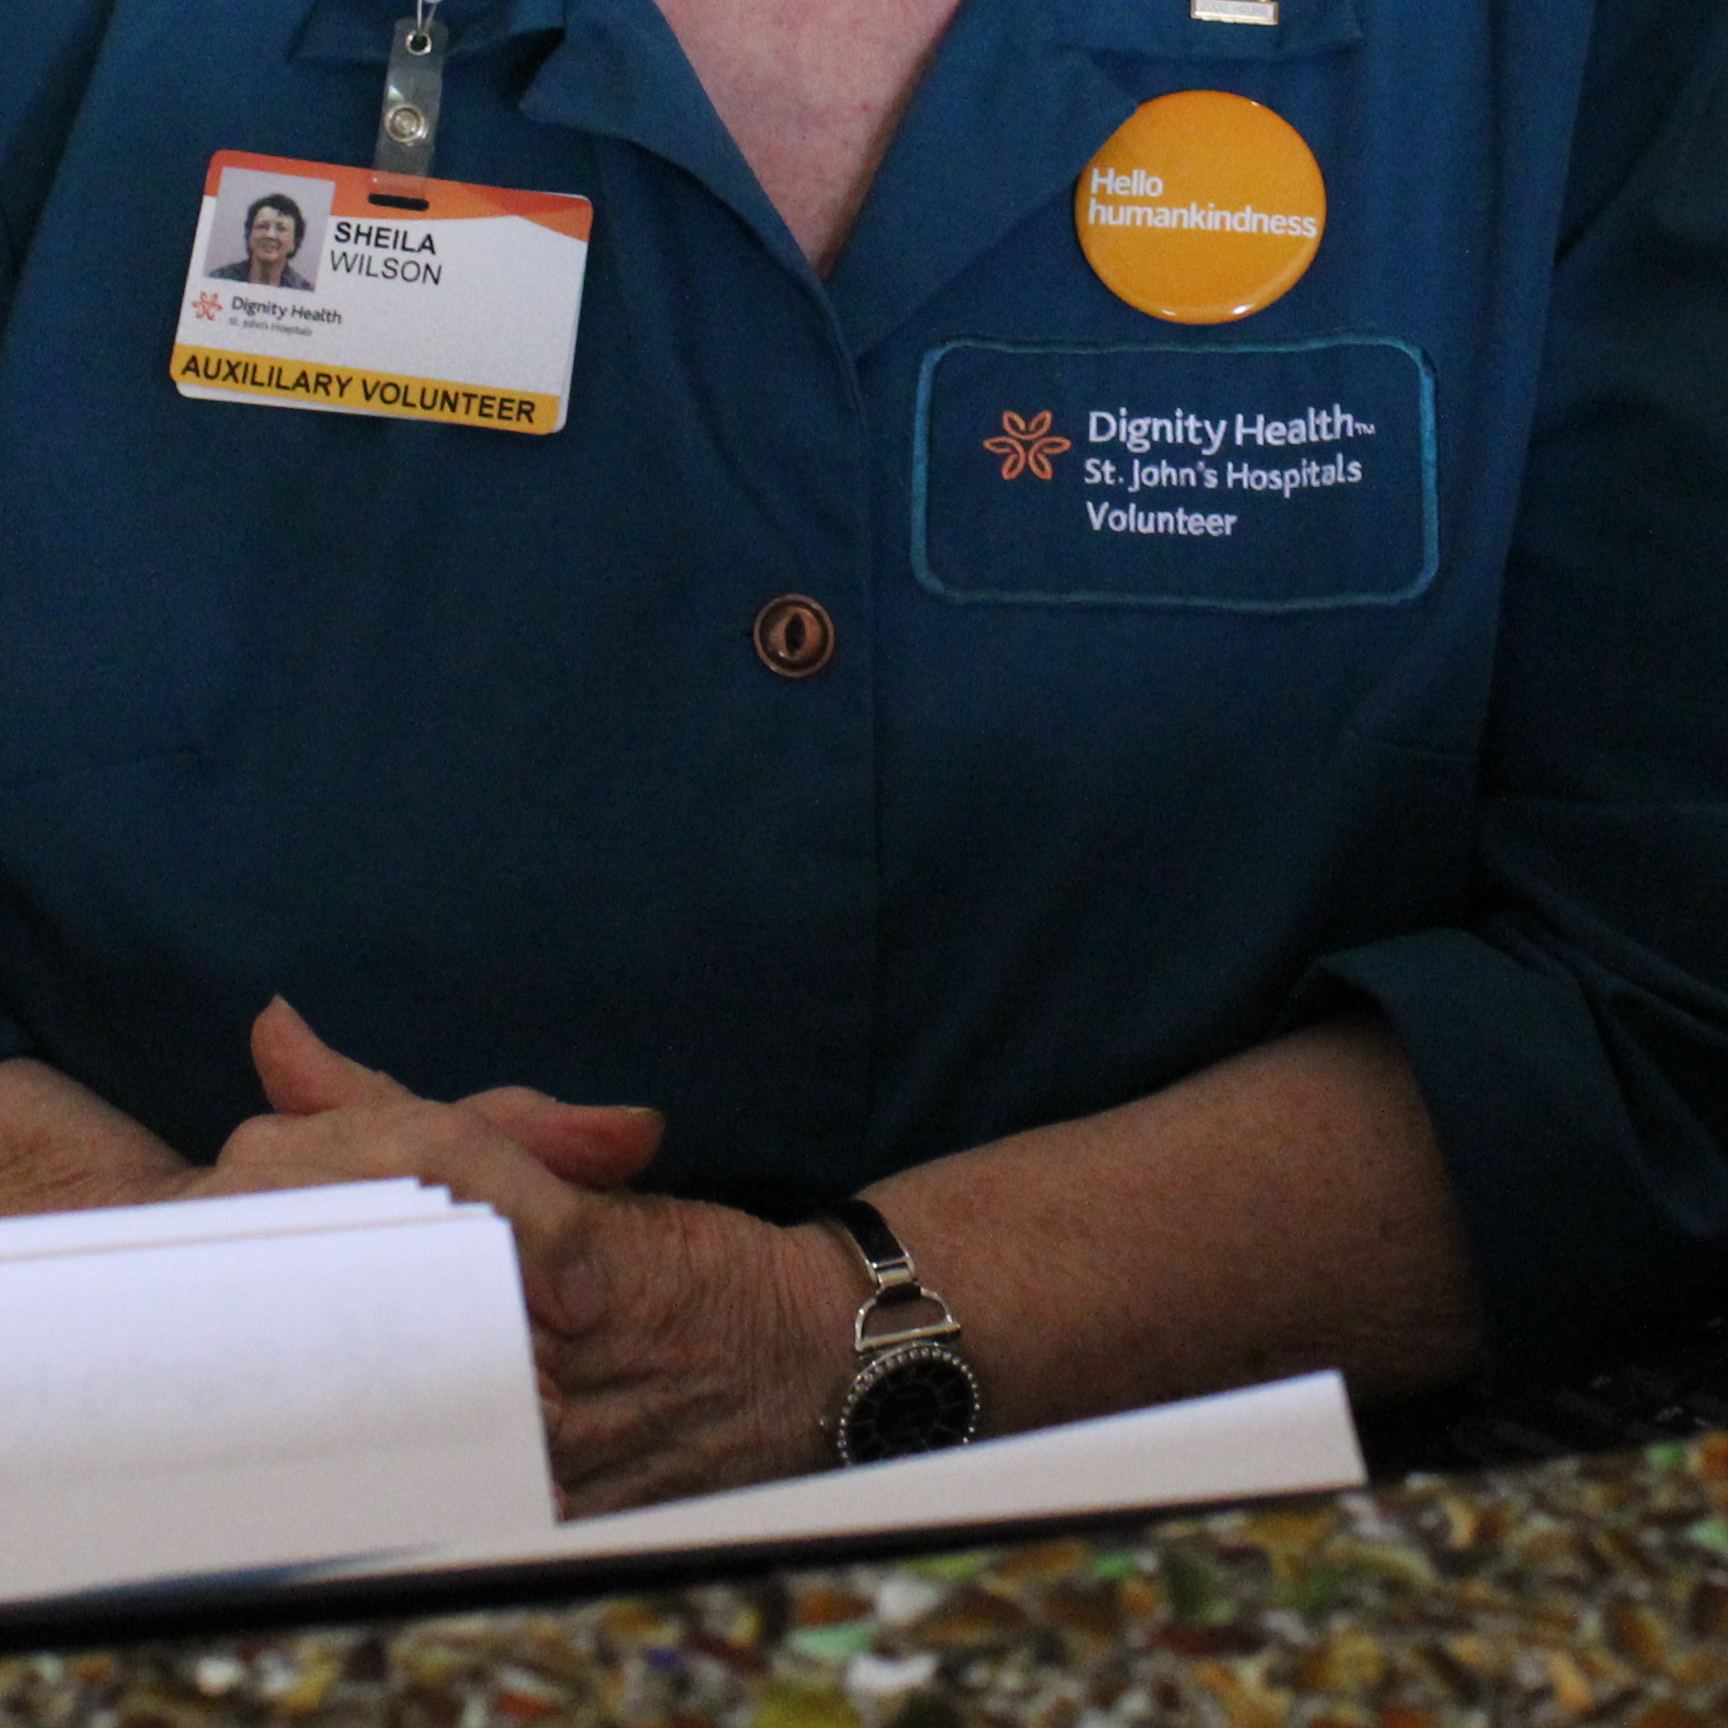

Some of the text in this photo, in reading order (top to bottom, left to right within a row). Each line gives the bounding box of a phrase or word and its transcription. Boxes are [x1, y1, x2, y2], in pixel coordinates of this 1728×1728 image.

[1090, 167, 1164, 197] Hello
[1088, 197, 1319, 239] humankindness
[334, 221, 437, 256] SHEILA
[329, 249, 444, 287] WILSON
[231, 296, 343, 324] Dignity Health
[180, 353, 537, 425] AUXILILARY VOLUNTEER
[1088, 407, 1227, 456] Dignity
[1083, 452, 1363, 499] St. John's Hospitals
[1086, 500, 1238, 537] Volunteer
